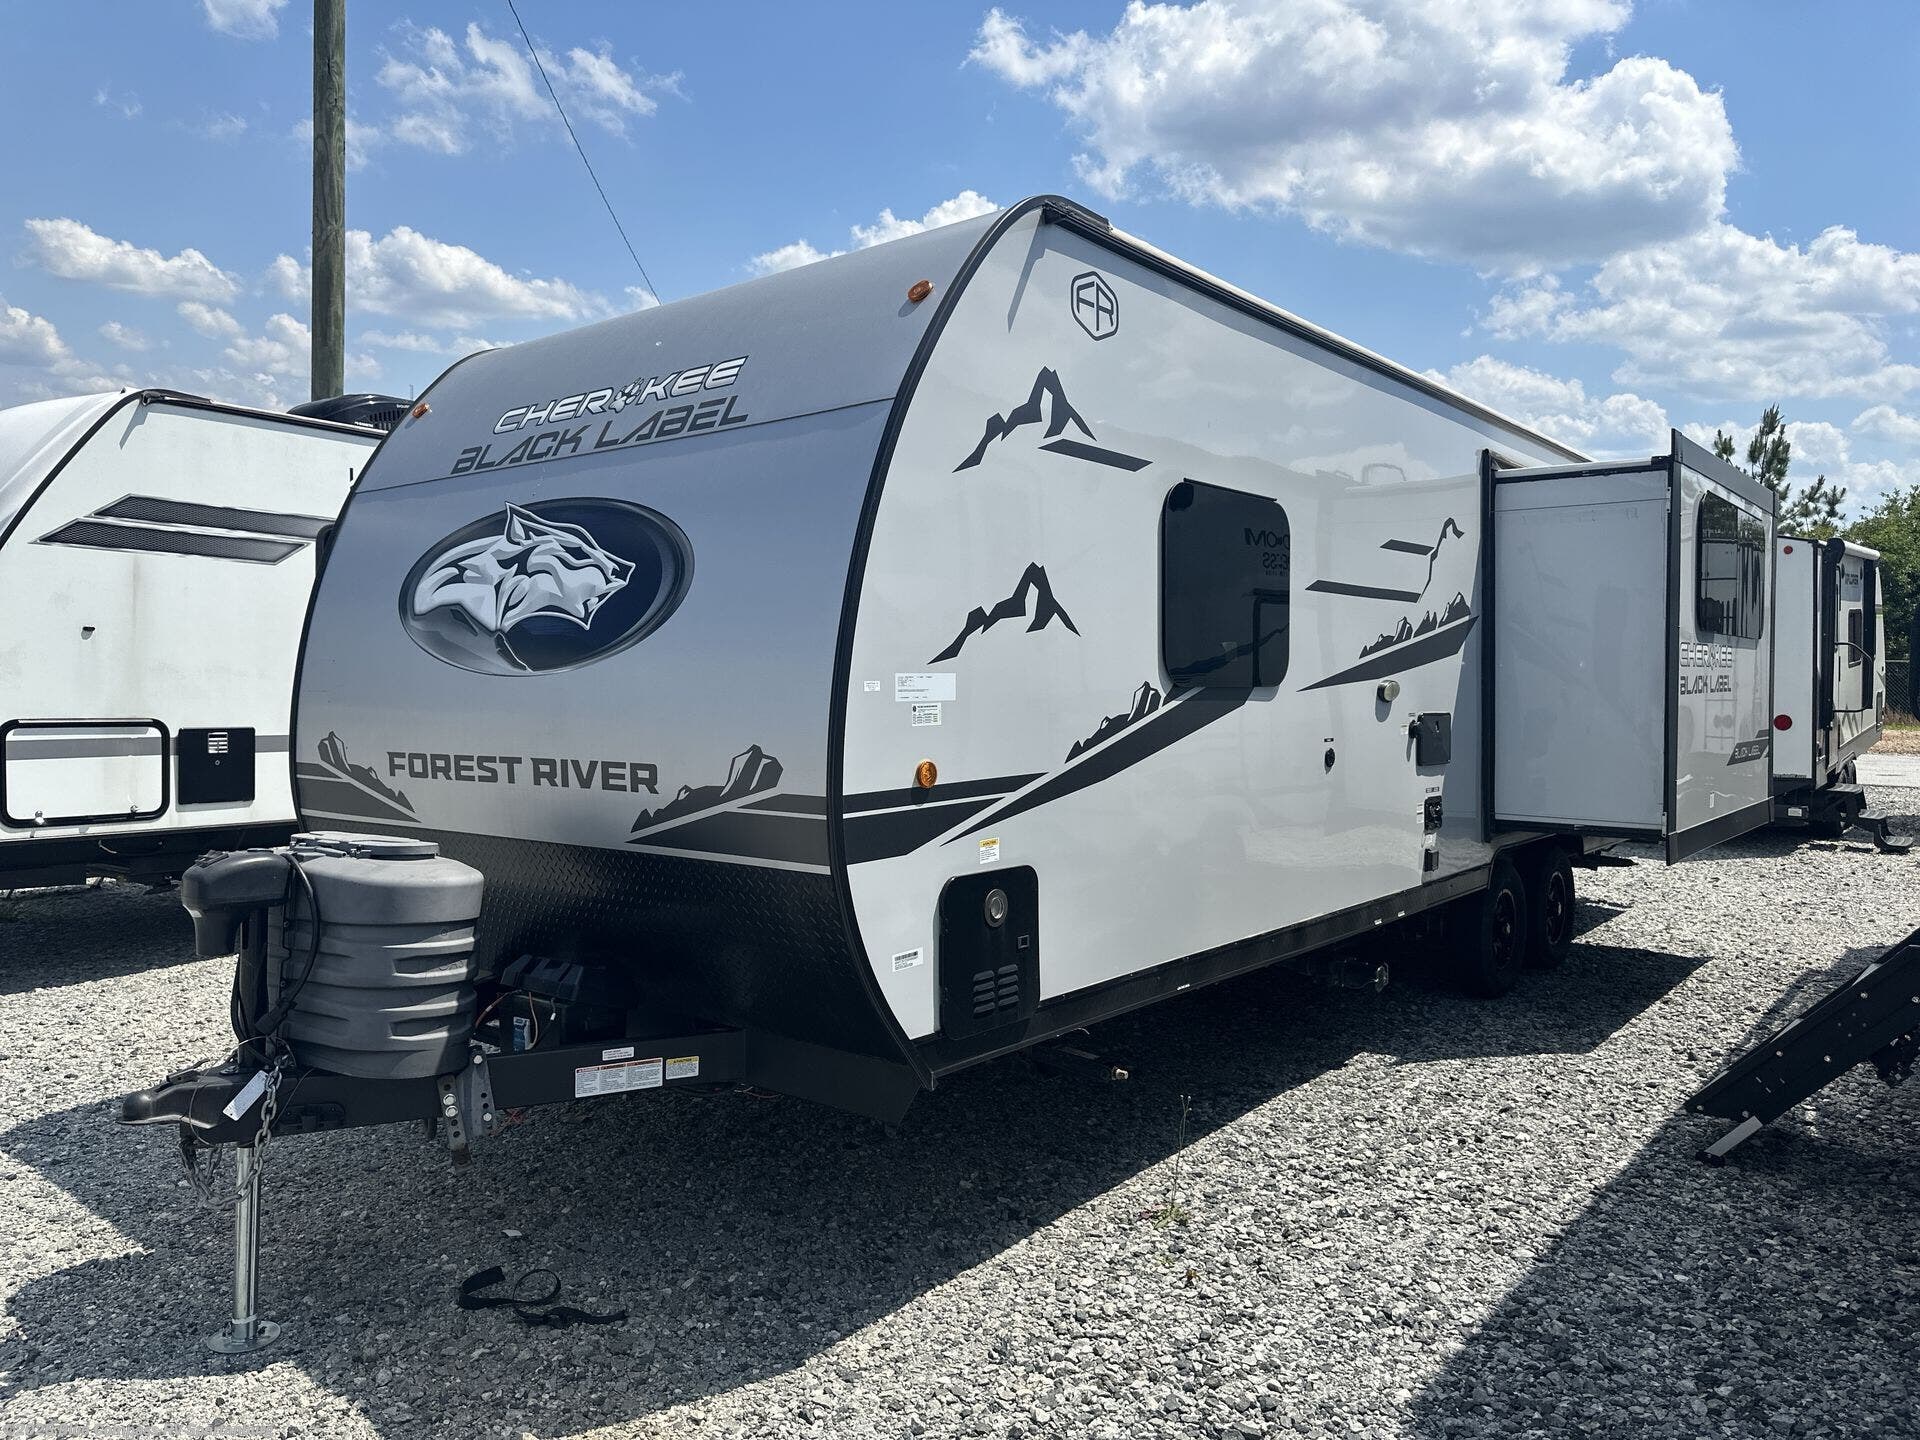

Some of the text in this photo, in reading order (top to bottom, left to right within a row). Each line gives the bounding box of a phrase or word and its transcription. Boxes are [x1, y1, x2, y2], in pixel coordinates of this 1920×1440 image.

[450, 395, 749, 475] BLACK LABEL
[1680, 674, 1732, 695] BLACK LABEL
[386, 751, 659, 795] FOREST RIVER
